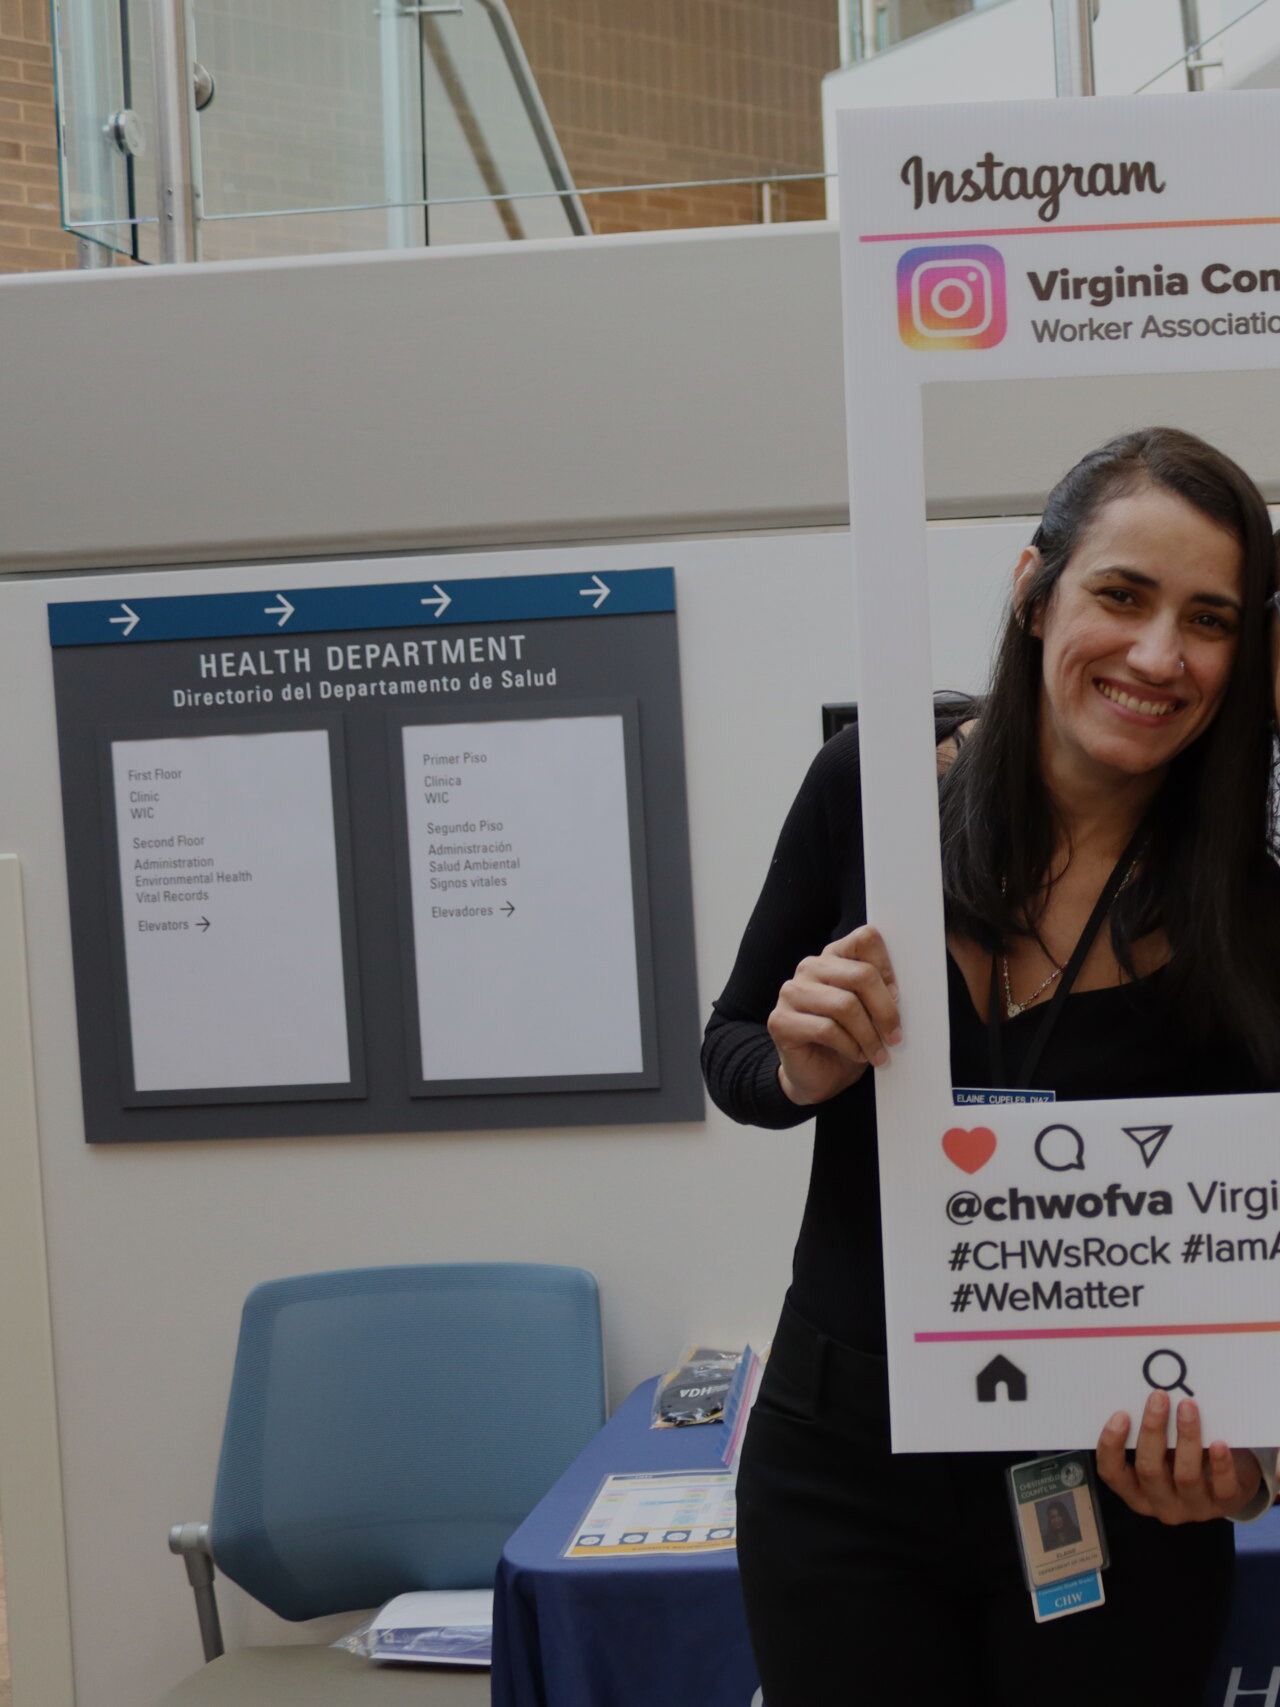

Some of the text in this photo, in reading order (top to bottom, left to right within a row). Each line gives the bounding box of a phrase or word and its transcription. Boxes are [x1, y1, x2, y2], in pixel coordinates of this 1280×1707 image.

[900, 152, 1166, 222] Instagram
[1027, 263, 1189, 306] Virginia
[1030, 315, 1132, 343] Worker
[199, 634, 527, 679] HEALTH DEPARTMENT
[172, 667, 557, 708] Directorio del Departamento de Salud
[423, 752, 487, 766] Primer Piso
[128, 769, 182, 781] First Floor
[130, 791, 160, 803] Clinic
[424, 792, 449, 804] WIC
[130, 807, 155, 819] WIC
[427, 820, 503, 836] Segundo Piso
[133, 835, 205, 849] Second Floor
[428, 842, 512, 856] Administración
[134, 857, 214, 870] Administration
[429, 857, 520, 873] Salud Ambiental
[135, 870, 253, 887] Environmental Health
[430, 876, 507, 892] Signos vitales
[136, 889, 209, 903] Vital Records
[431, 906, 493, 918] Elevadores
[138, 920, 189, 932] Elevators
[956, 1094, 986, 1104] ELAINE
[946, 1183, 1174, 1227] @chwofva
[948, 1234, 1171, 1273] #CHWsRock
[949, 1280, 1144, 1315] #WeMatter
[1054, 1592, 1083, 1608] CHW
